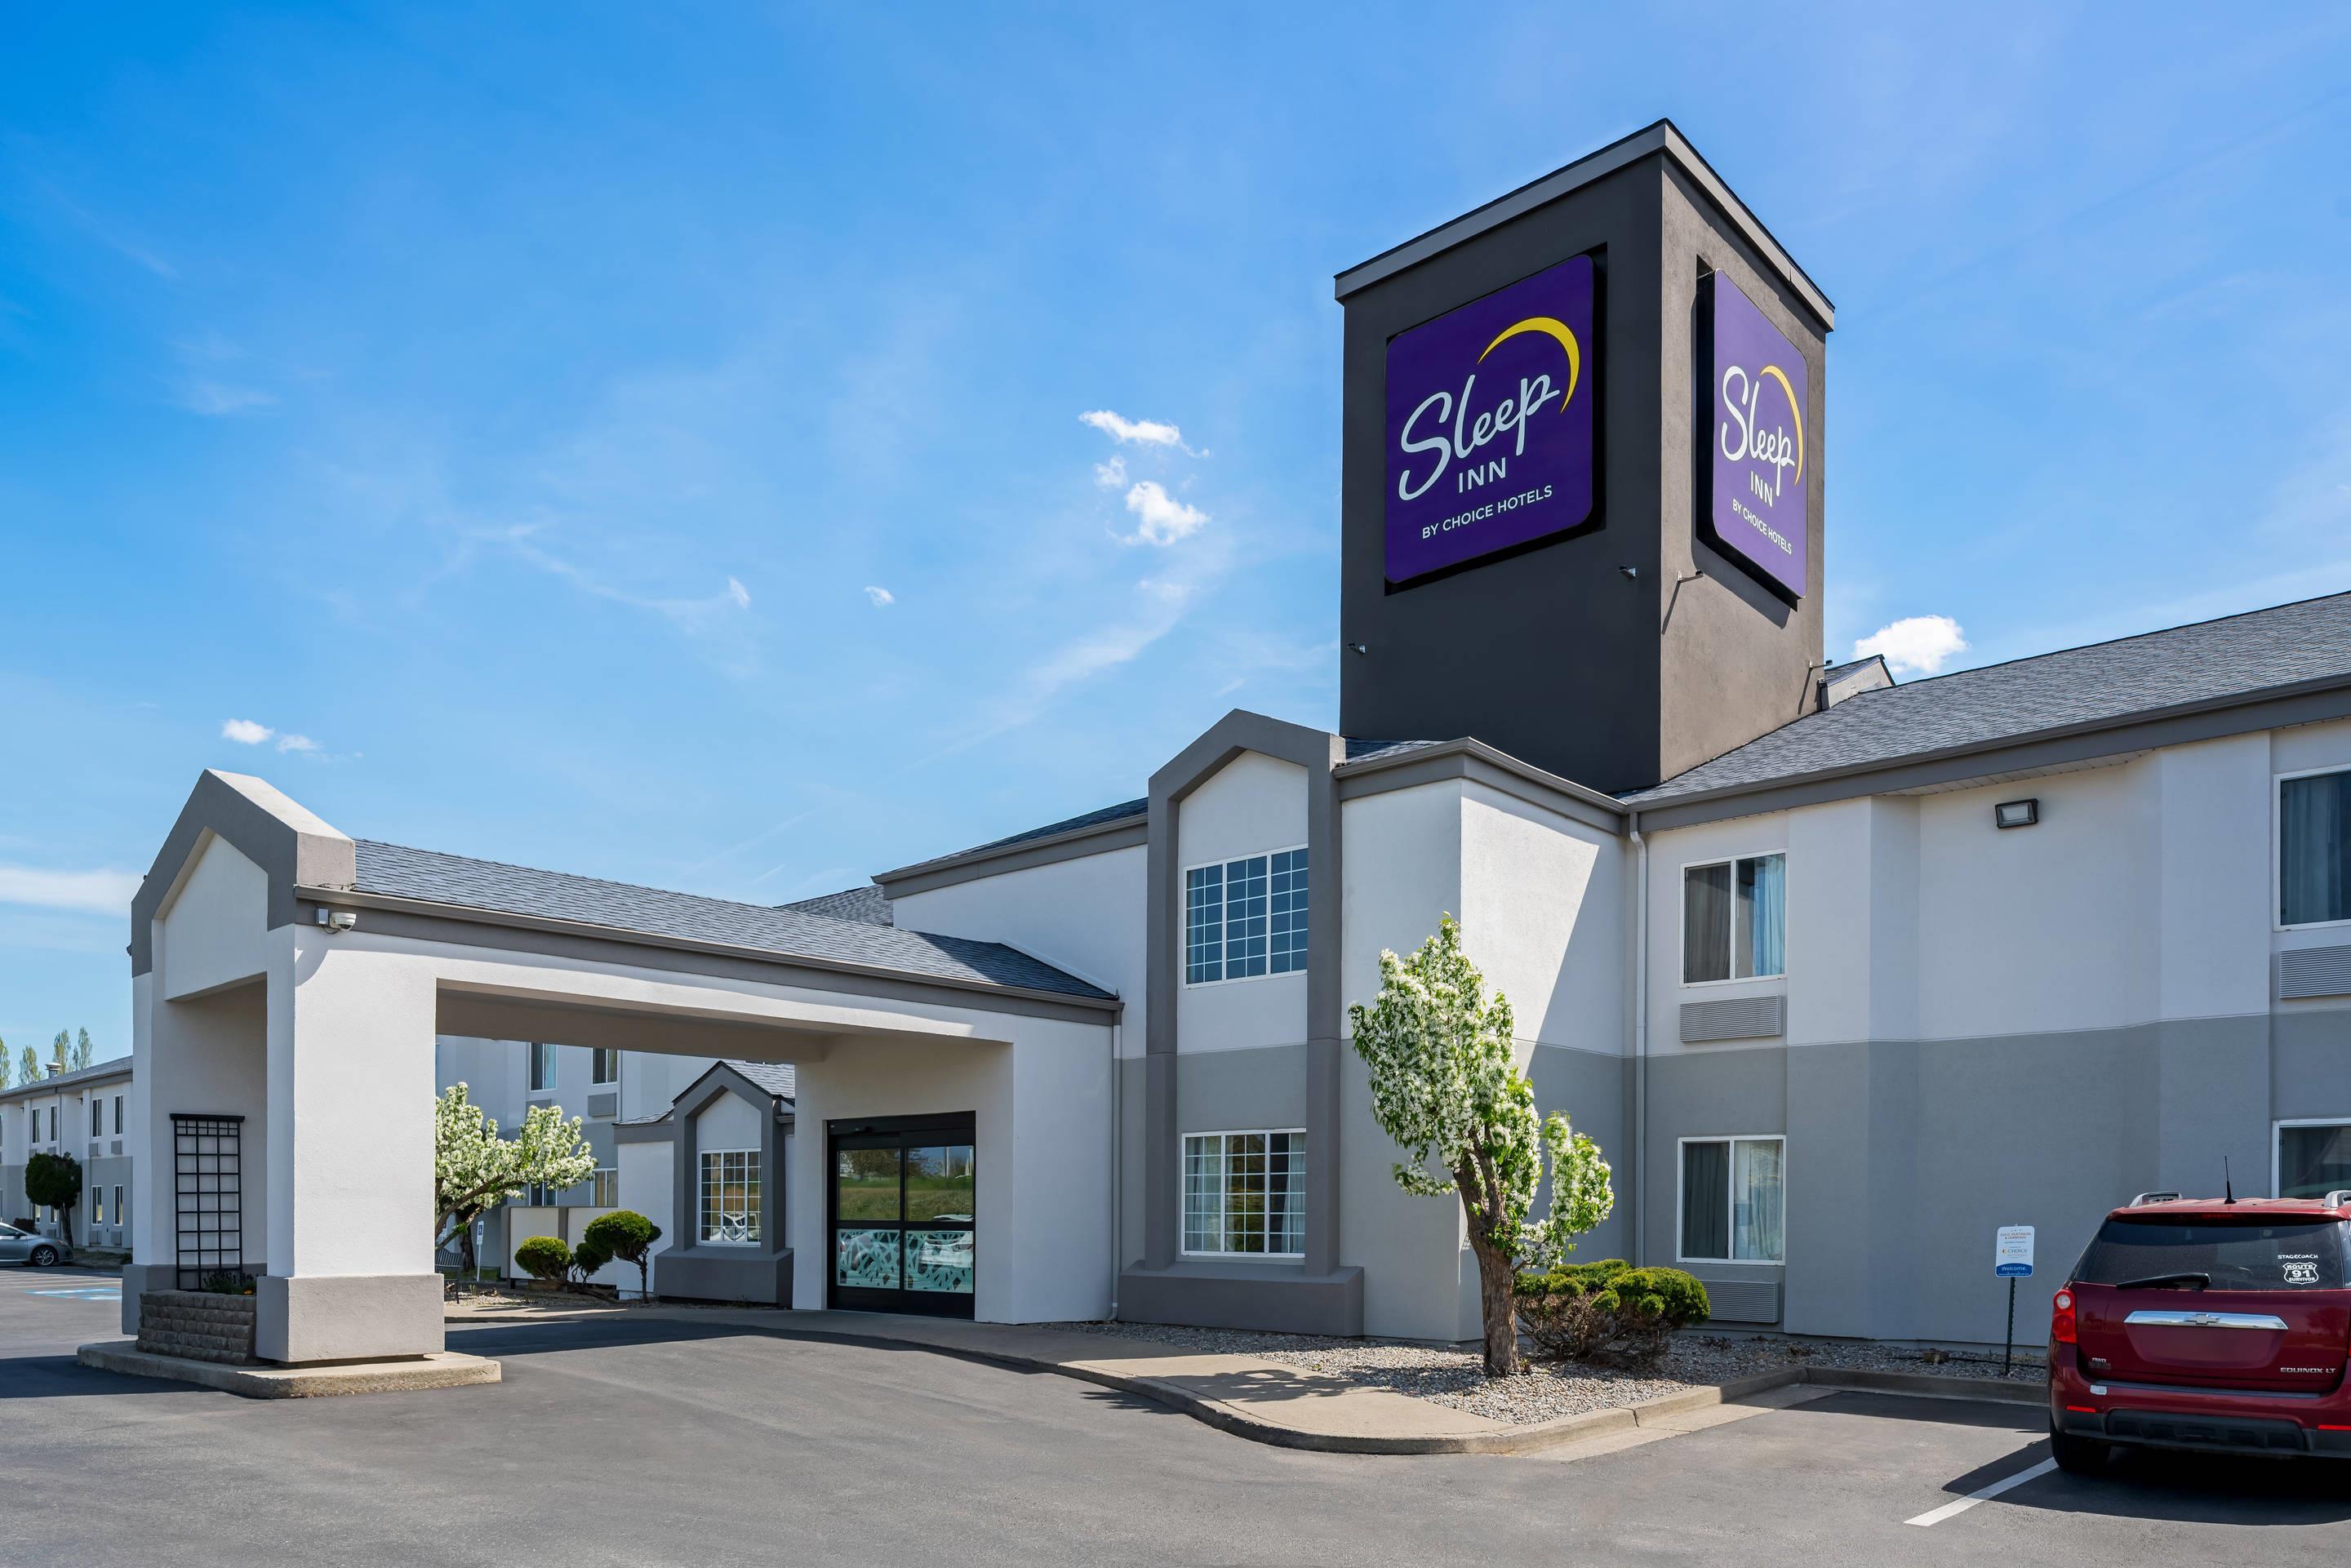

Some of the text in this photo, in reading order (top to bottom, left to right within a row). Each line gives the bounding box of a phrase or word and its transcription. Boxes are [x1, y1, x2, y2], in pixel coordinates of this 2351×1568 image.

[1398, 374, 1561, 501] Sleep
[1721, 365, 1796, 497] Sleep
[1459, 456, 1507, 494] INN
[1750, 470, 1773, 508] INN
[1422, 485, 1553, 540] BY CHOICE HOTELS
[1732, 498, 1793, 555] BY CHOICE HOTELS
